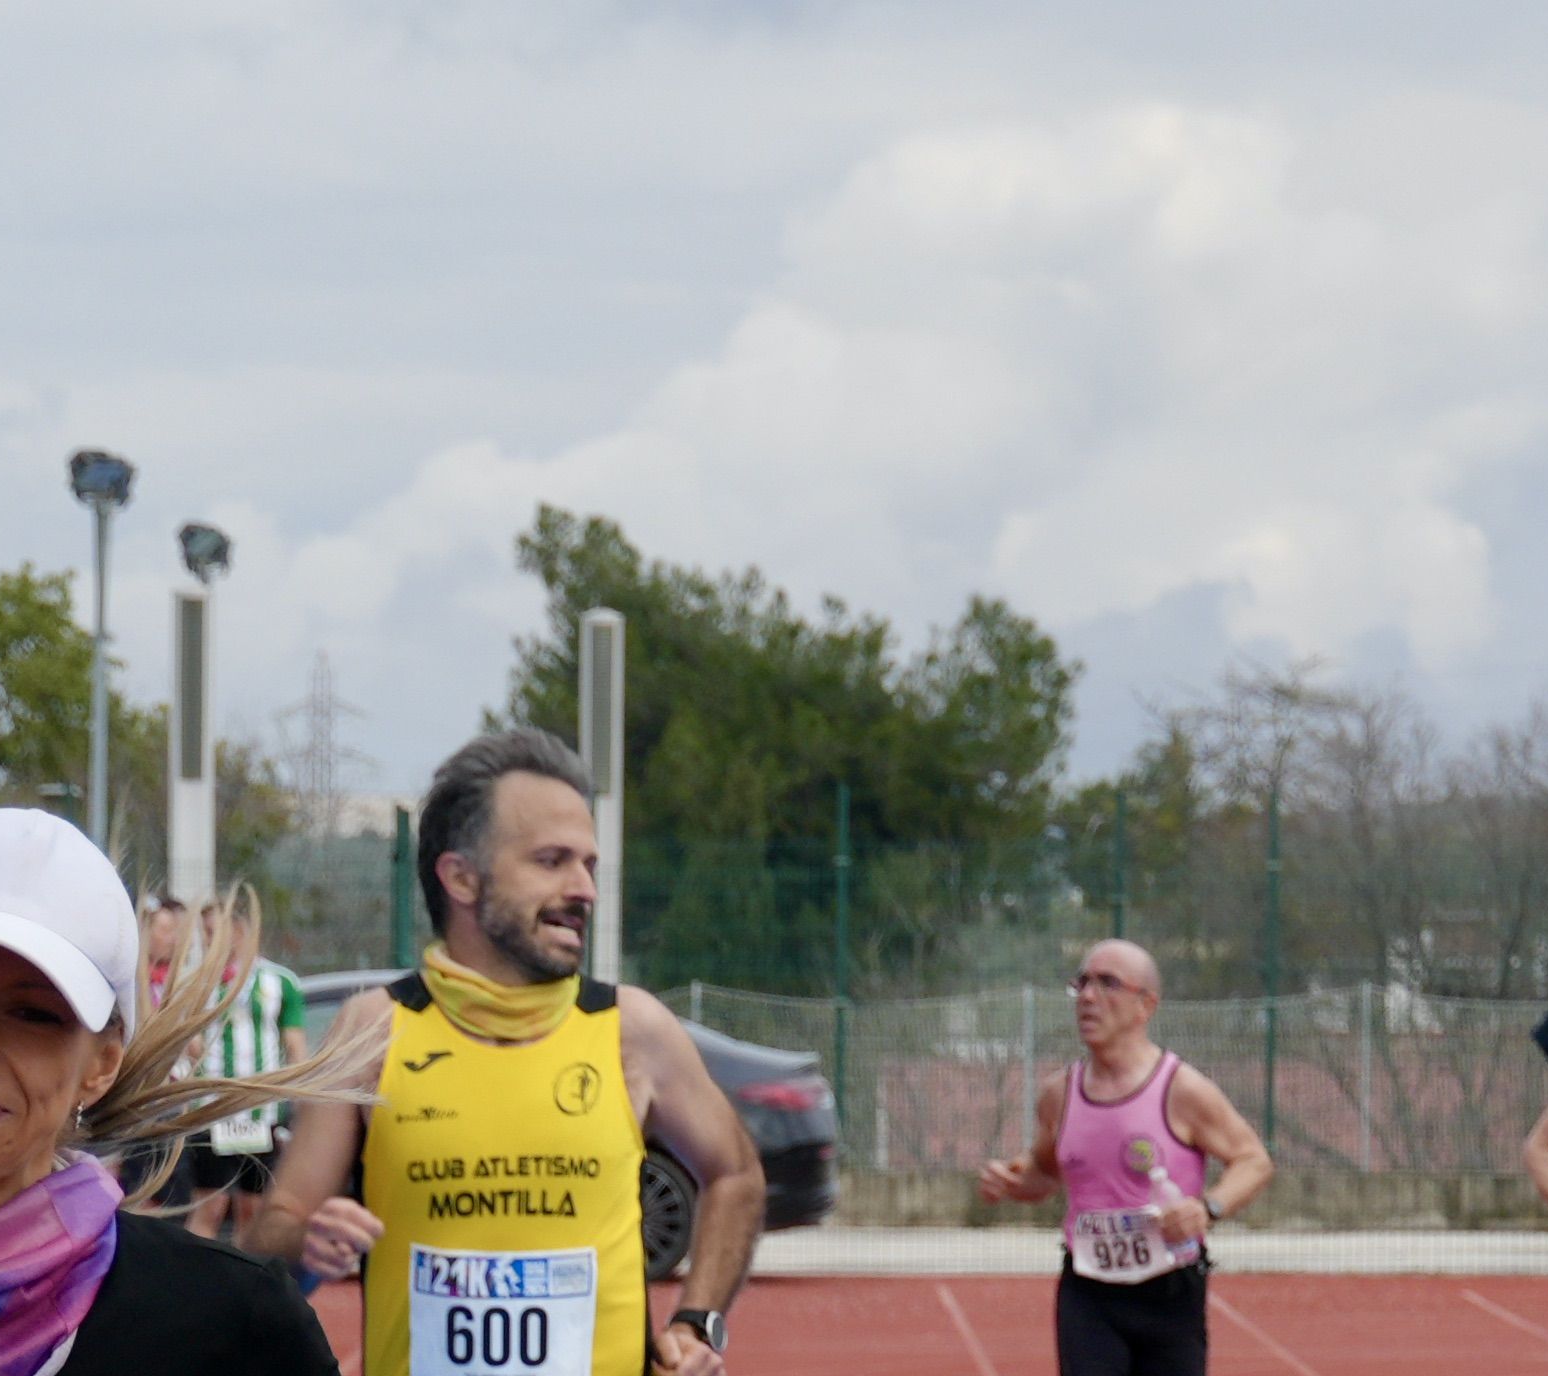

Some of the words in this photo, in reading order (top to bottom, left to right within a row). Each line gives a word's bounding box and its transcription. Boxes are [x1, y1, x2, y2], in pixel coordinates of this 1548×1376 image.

[407, 1158, 466, 1183] CLUB
[474, 1155, 602, 1179] ATLETISMO
[428, 1189, 577, 1221] MONTILLA
[1094, 1233, 1150, 1271] 926
[432, 1256, 492, 1298] 21K
[446, 1304, 549, 1367] 600
